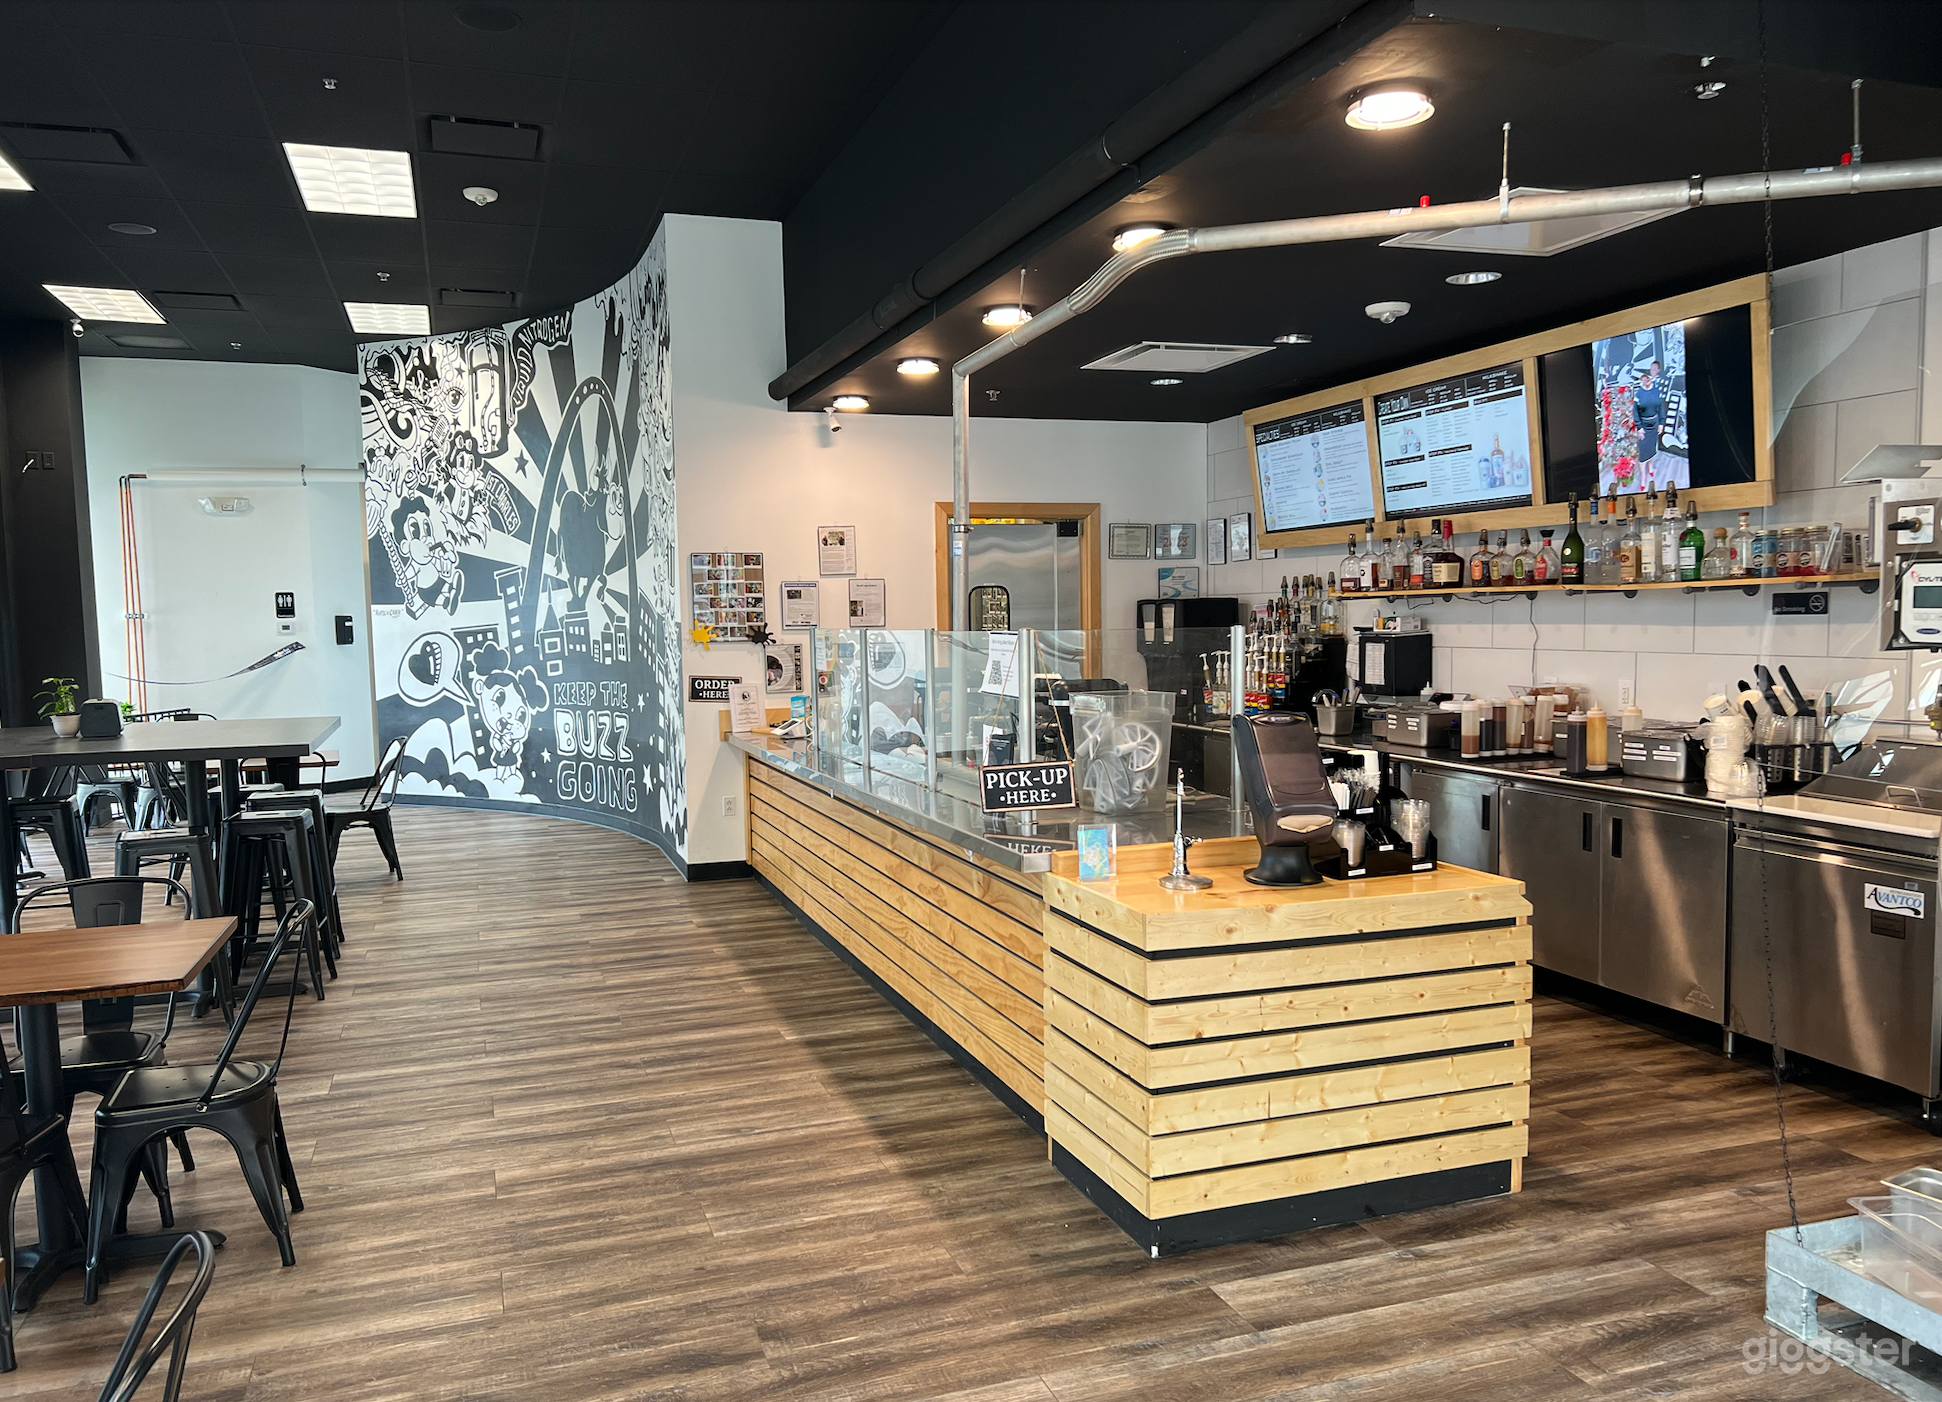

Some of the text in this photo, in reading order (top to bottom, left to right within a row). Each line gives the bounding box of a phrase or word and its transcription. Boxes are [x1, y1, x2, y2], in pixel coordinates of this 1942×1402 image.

[512, 310, 570, 405] LIQUID NITROGEN
[495, 483, 518, 531] CHARLES
[554, 680, 629, 709] KEEP THE
[554, 708, 634, 763] BUZZ
[556, 760, 638, 812] GOING
[985, 767, 1068, 790] PICK-UP
[1005, 788, 1051, 805] HERE
[1866, 887, 1922, 908] AVANTCO
